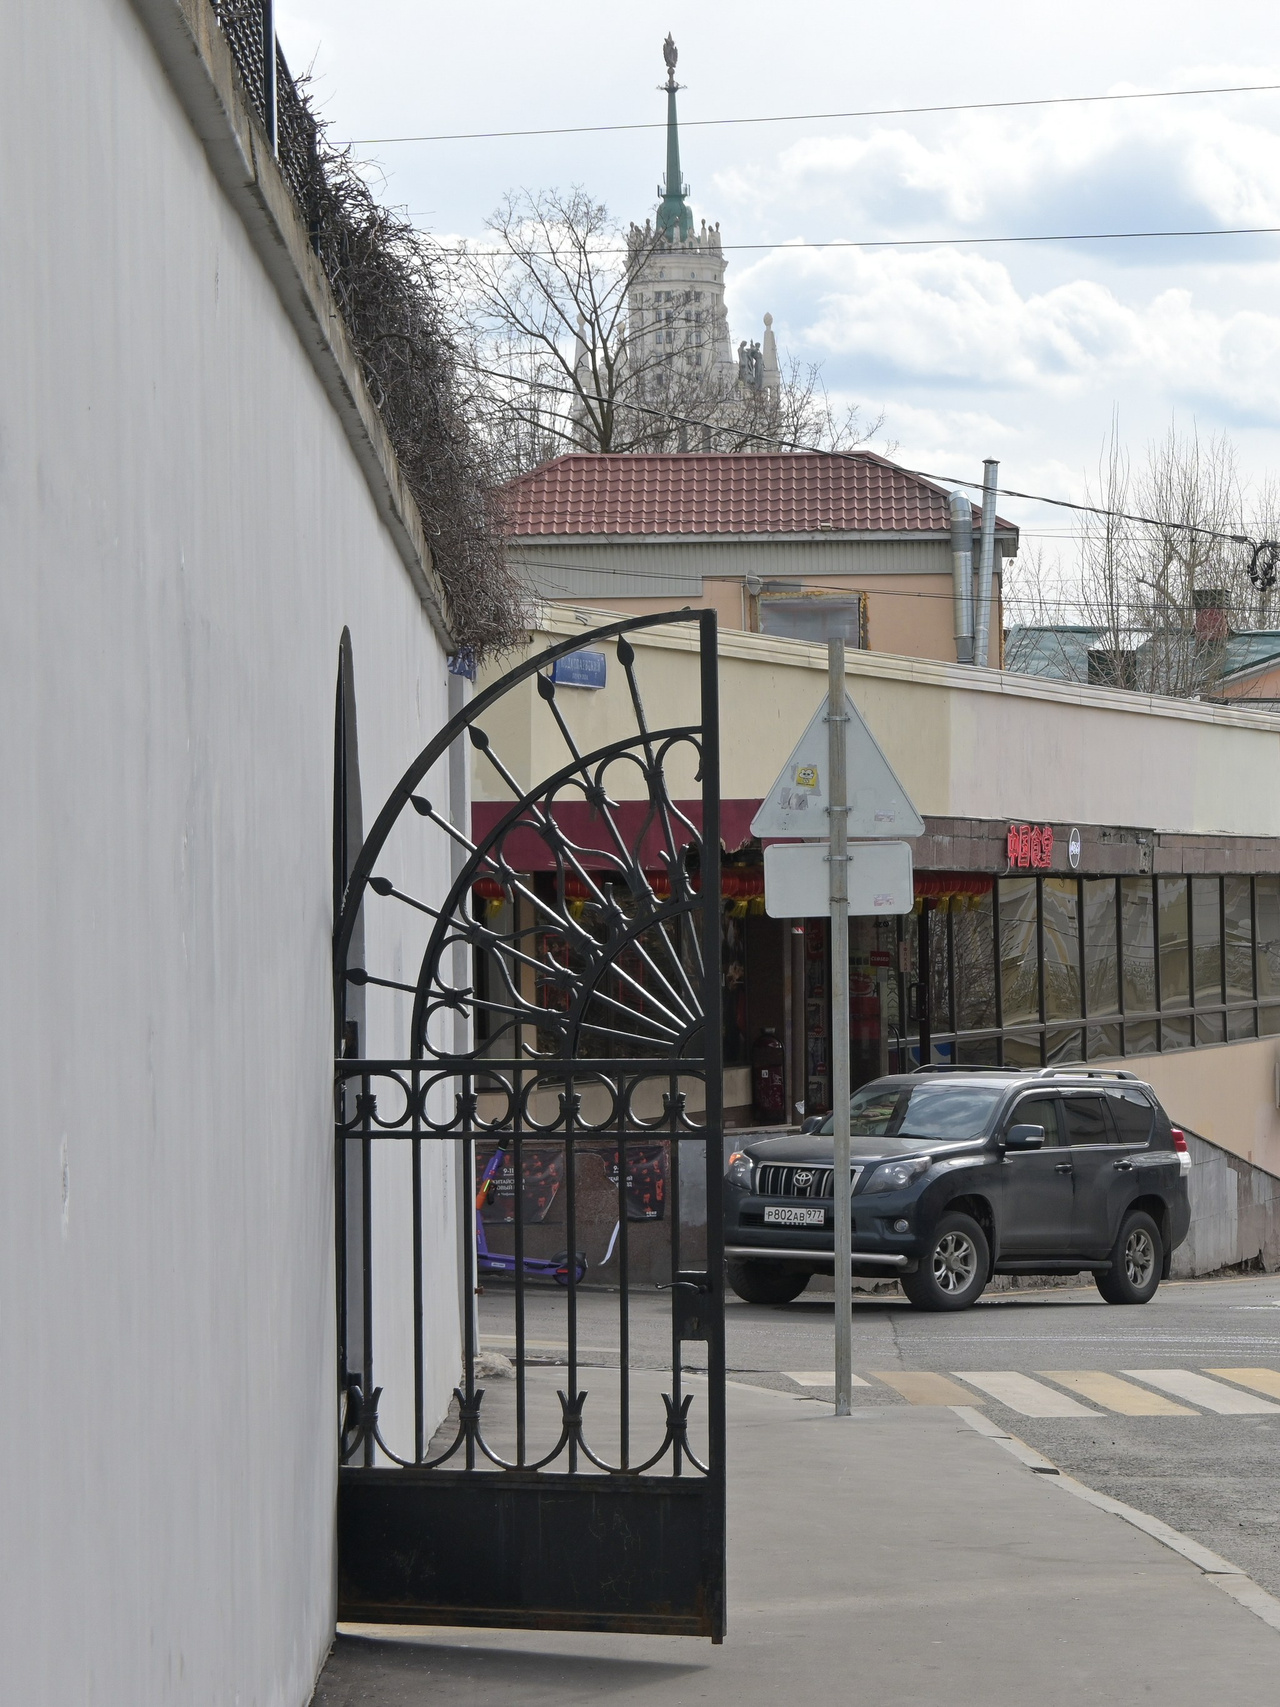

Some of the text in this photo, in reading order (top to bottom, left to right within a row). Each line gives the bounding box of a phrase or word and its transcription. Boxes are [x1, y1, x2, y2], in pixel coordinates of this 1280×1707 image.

[1007, 825, 1053, 868] 中国食堂
[767, 1208, 822, 1222] Р802АВ 977
